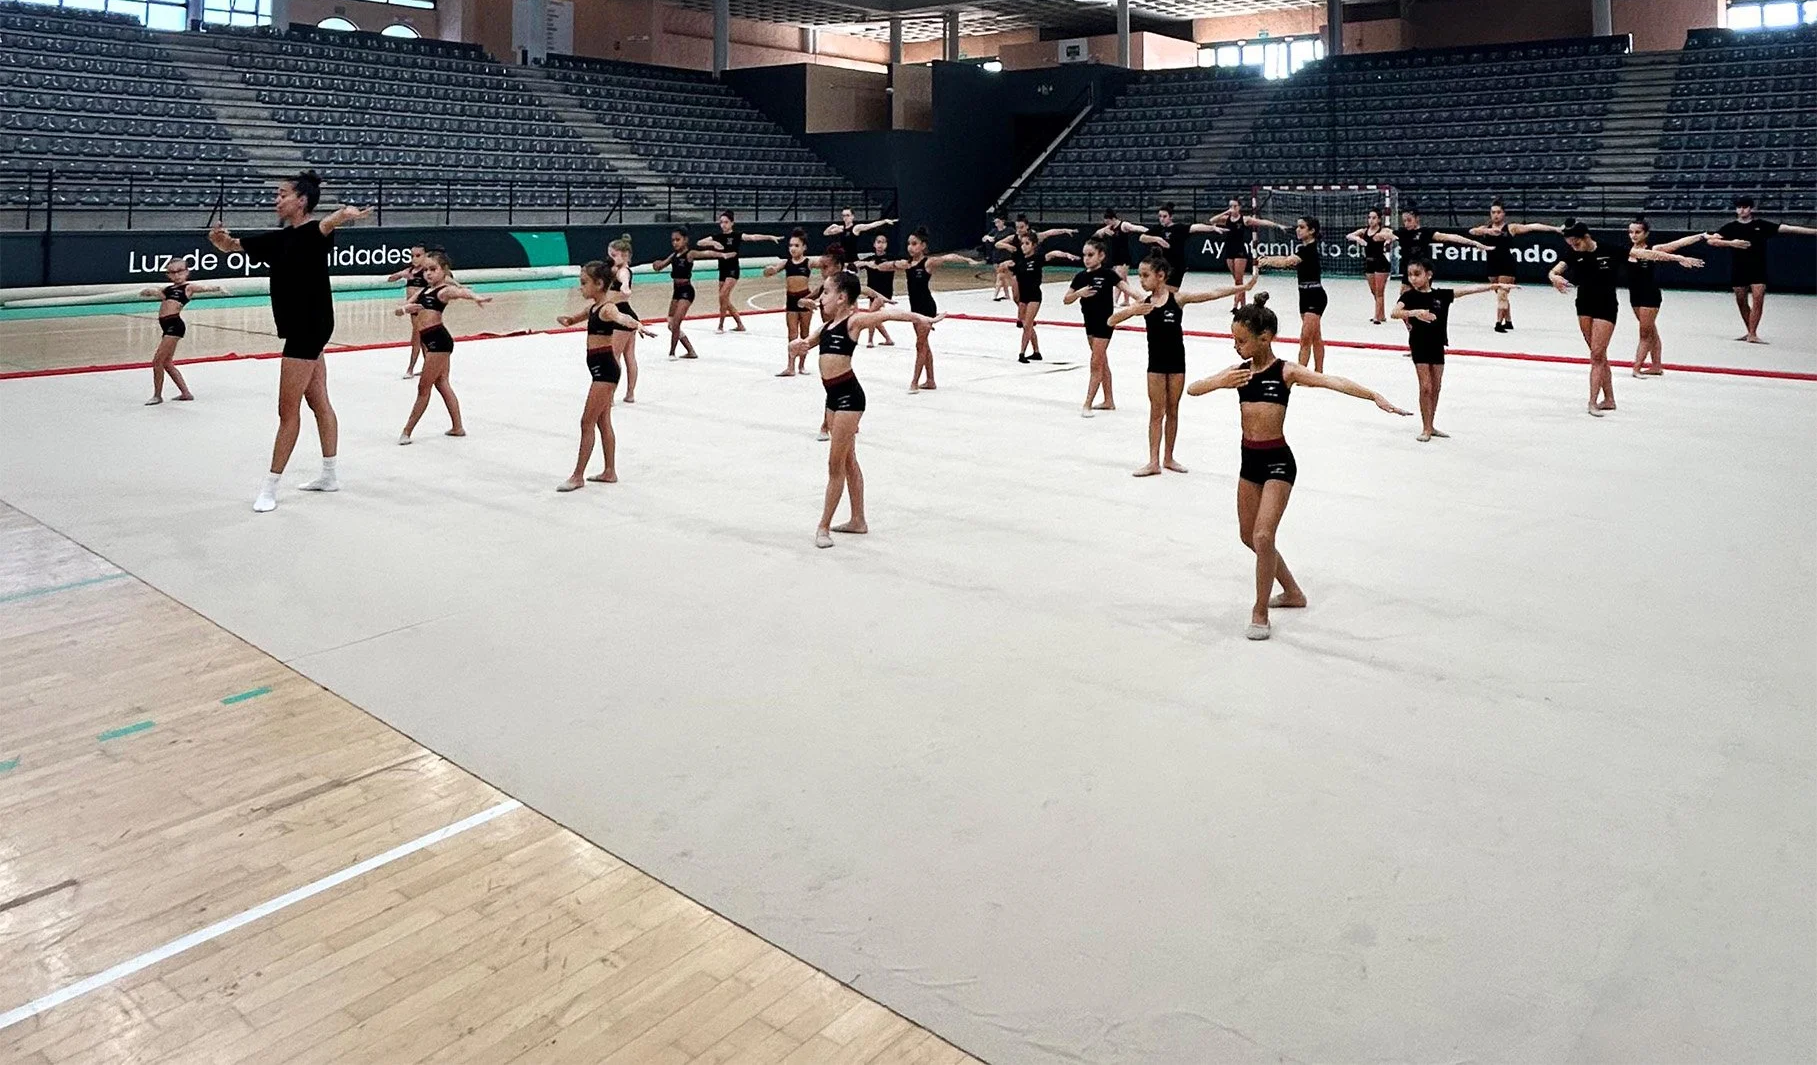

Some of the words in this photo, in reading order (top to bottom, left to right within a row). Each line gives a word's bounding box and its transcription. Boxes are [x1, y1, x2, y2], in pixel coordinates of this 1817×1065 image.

[129, 251, 172, 273] Luz
[182, 249, 218, 271] de
[1430, 243, 1558, 263] Fernndo
